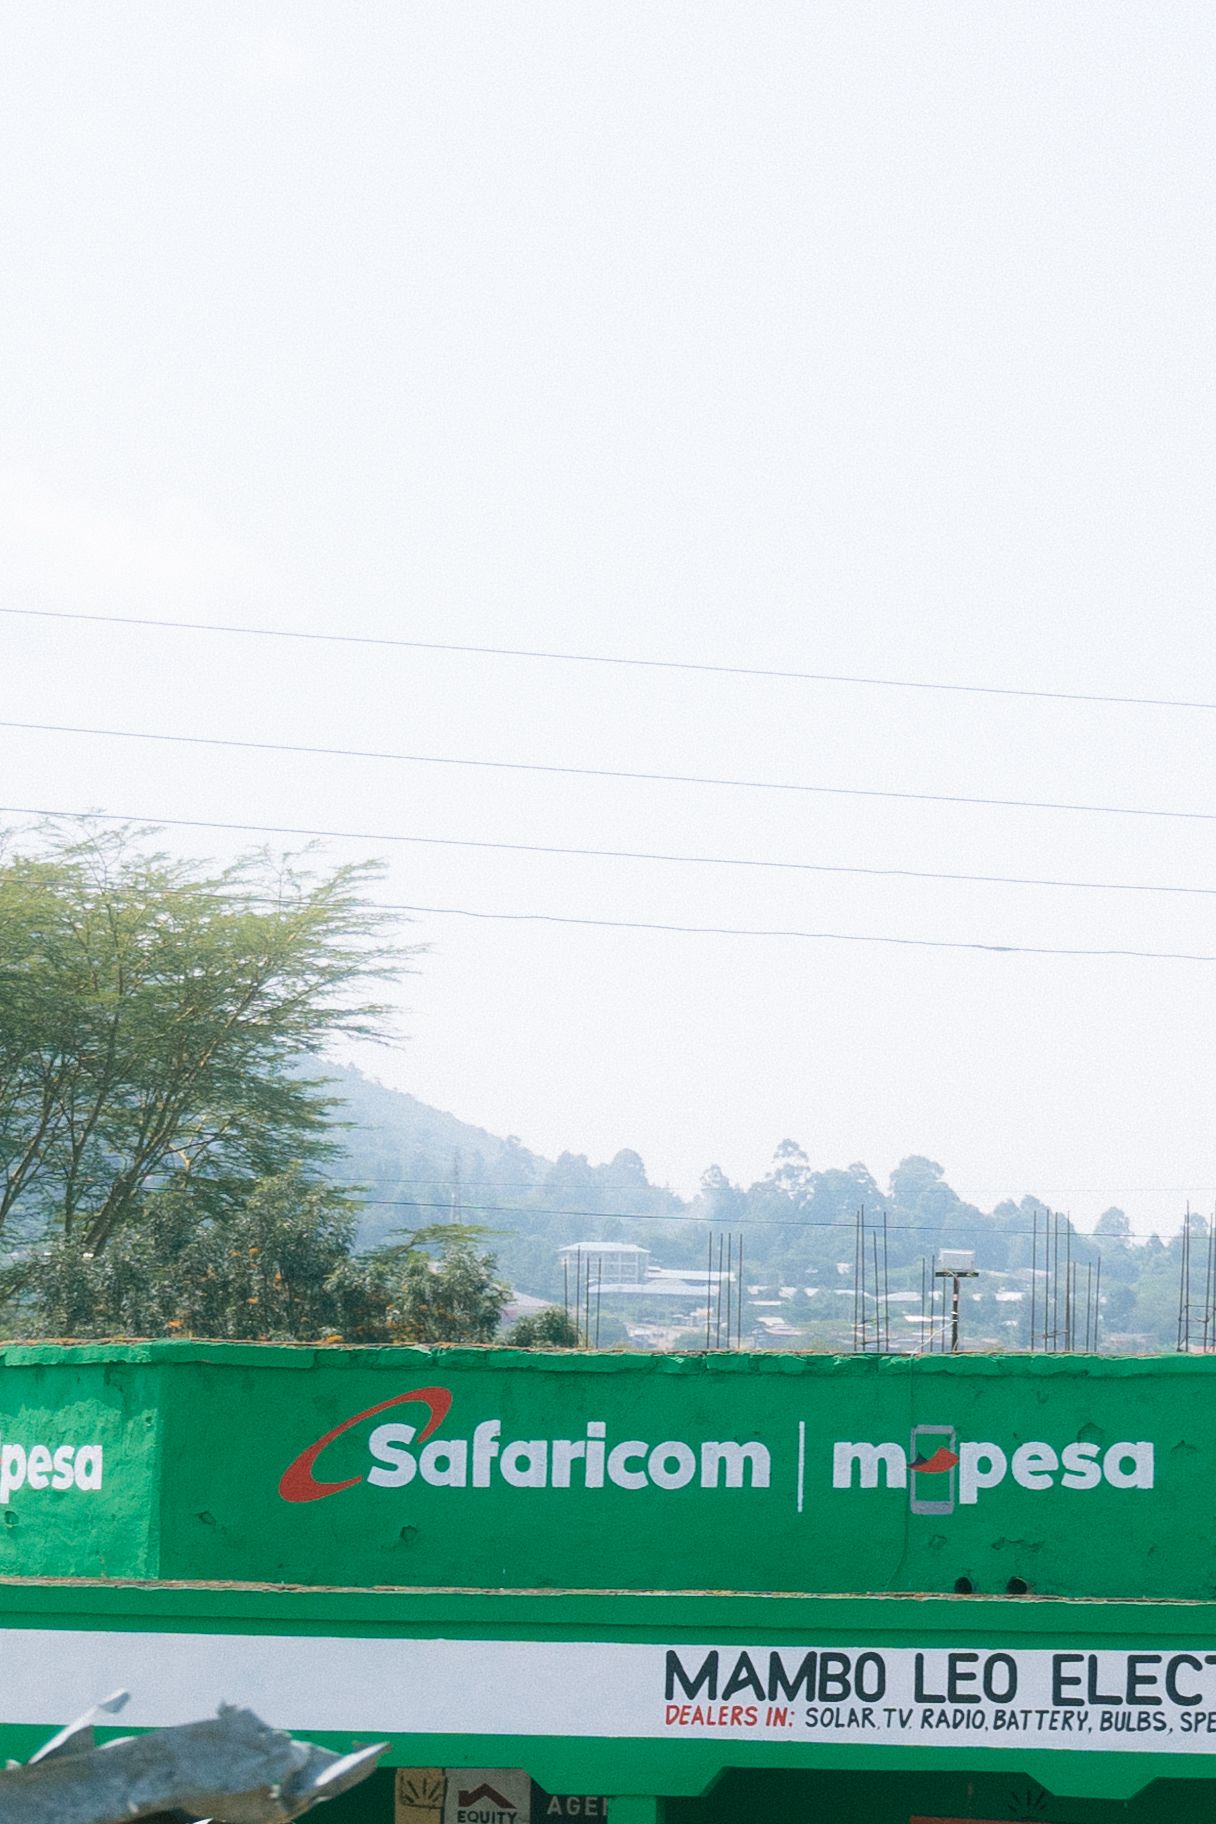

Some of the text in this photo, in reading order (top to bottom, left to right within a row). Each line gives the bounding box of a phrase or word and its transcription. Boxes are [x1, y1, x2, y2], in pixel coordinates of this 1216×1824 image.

[367, 1420, 771, 1490] Safaricom
[665, 1649, 886, 1703] MAMBO
[914, 1652, 1018, 1706] LEO
[665, 1705, 758, 1727] DEALERS
[766, 1706, 795, 1728] IN:
[1099, 1710, 1173, 1736] BULBS,
[457, 1810, 518, 1824] EQUITY
